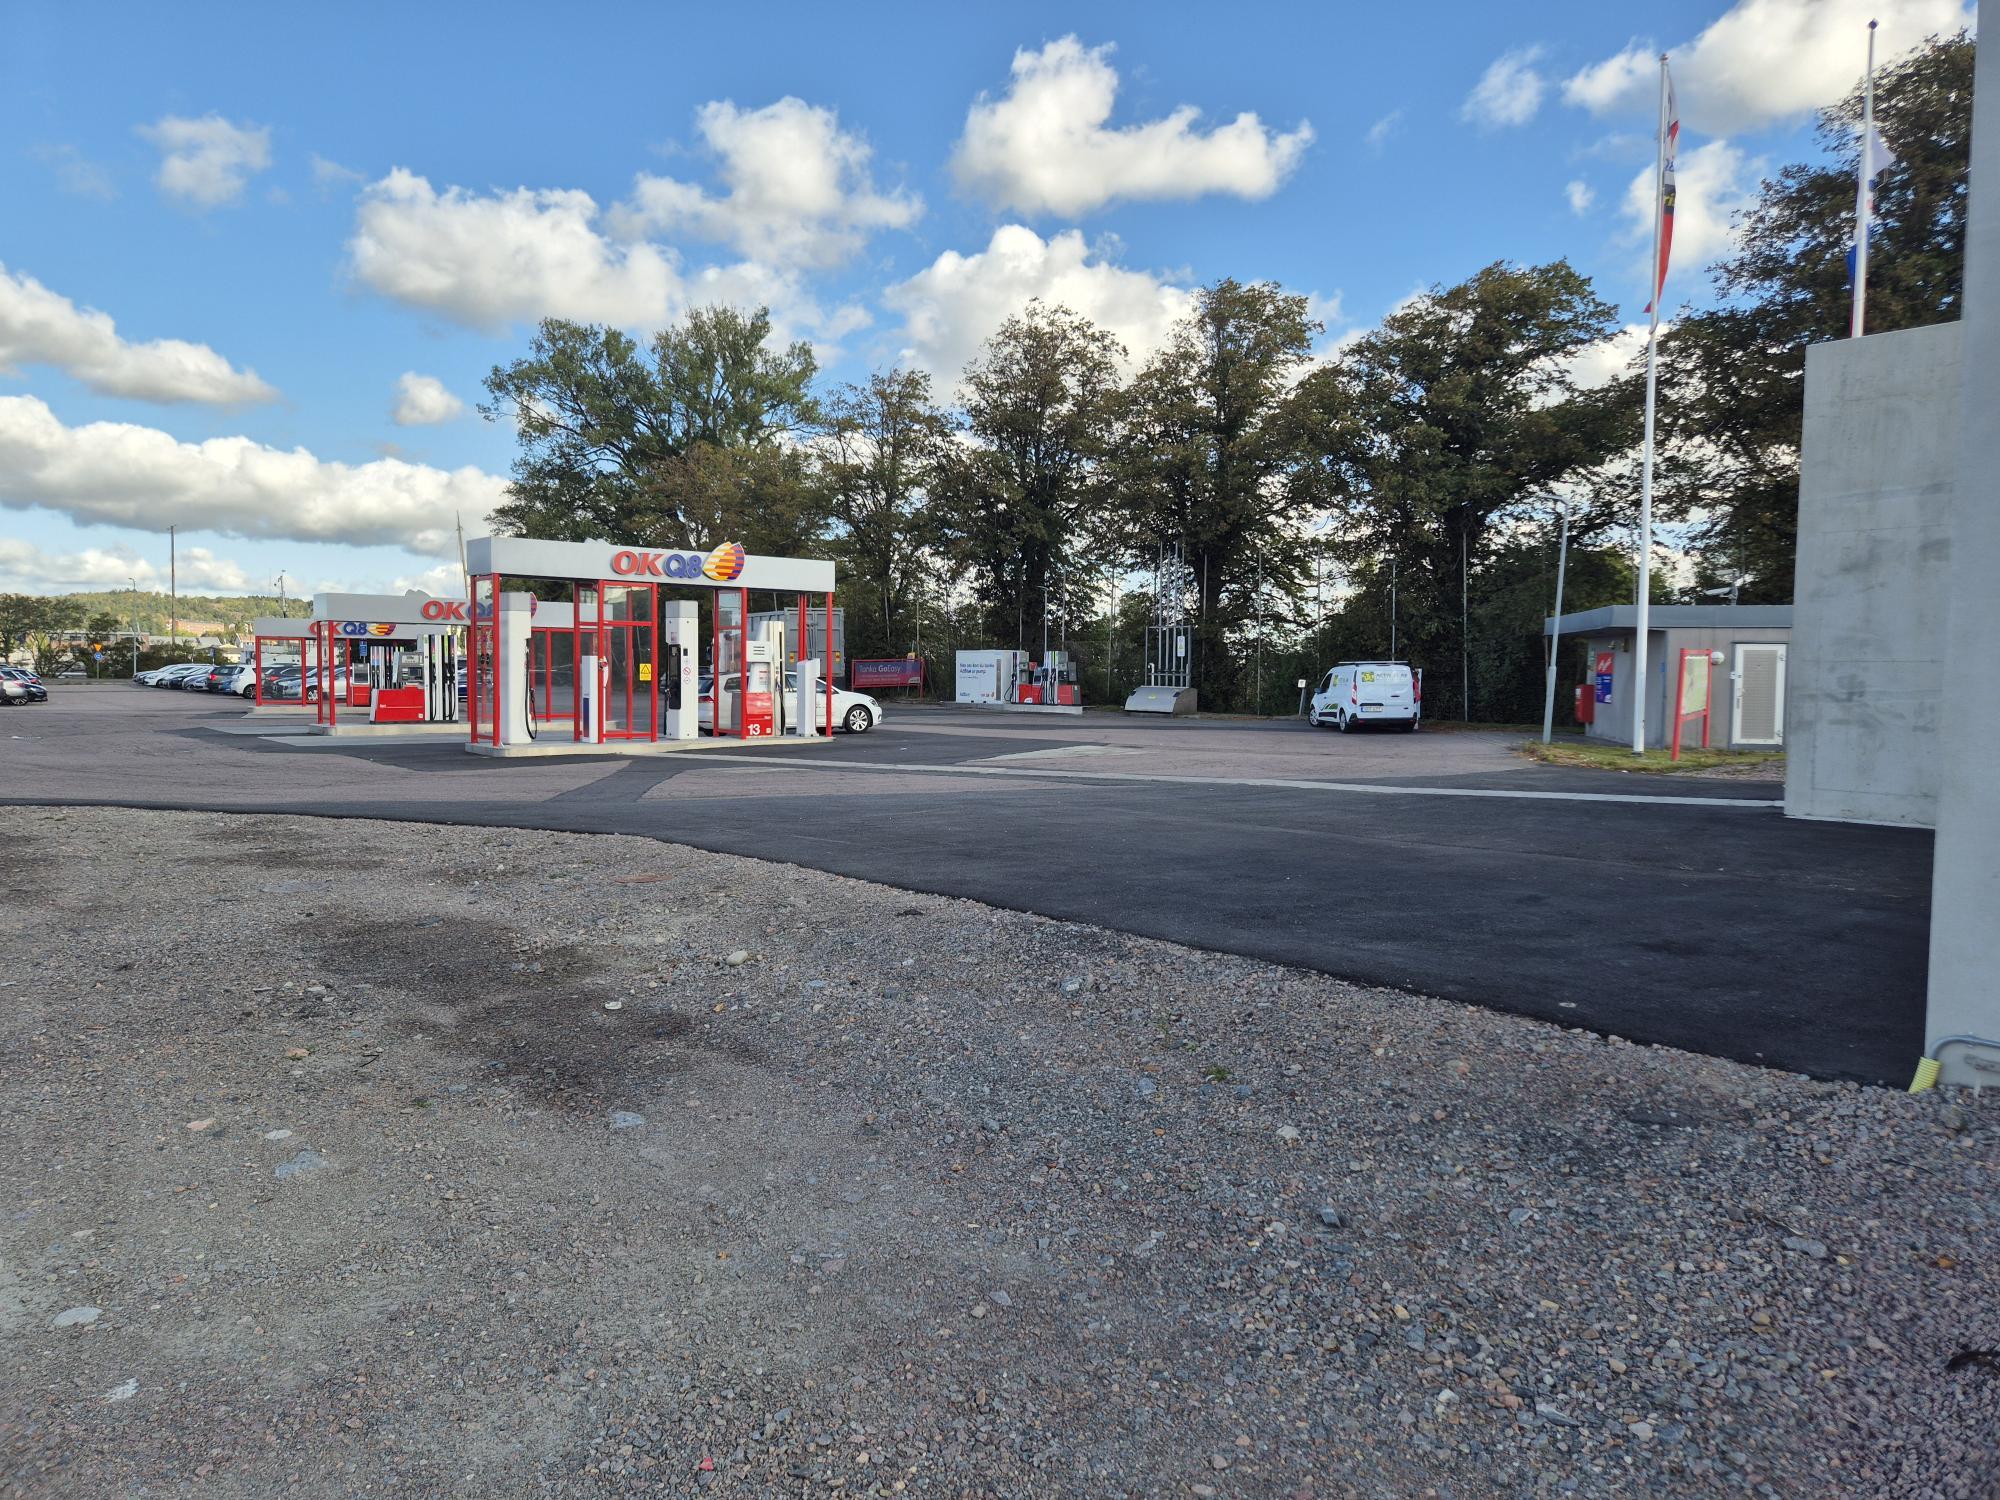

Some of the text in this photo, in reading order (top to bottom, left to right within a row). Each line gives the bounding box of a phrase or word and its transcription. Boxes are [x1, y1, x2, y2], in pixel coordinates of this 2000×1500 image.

[612, 550, 702, 578] OKQ8
[878, 664, 901, 675] GoEasy
[747, 723, 761, 735] 13
